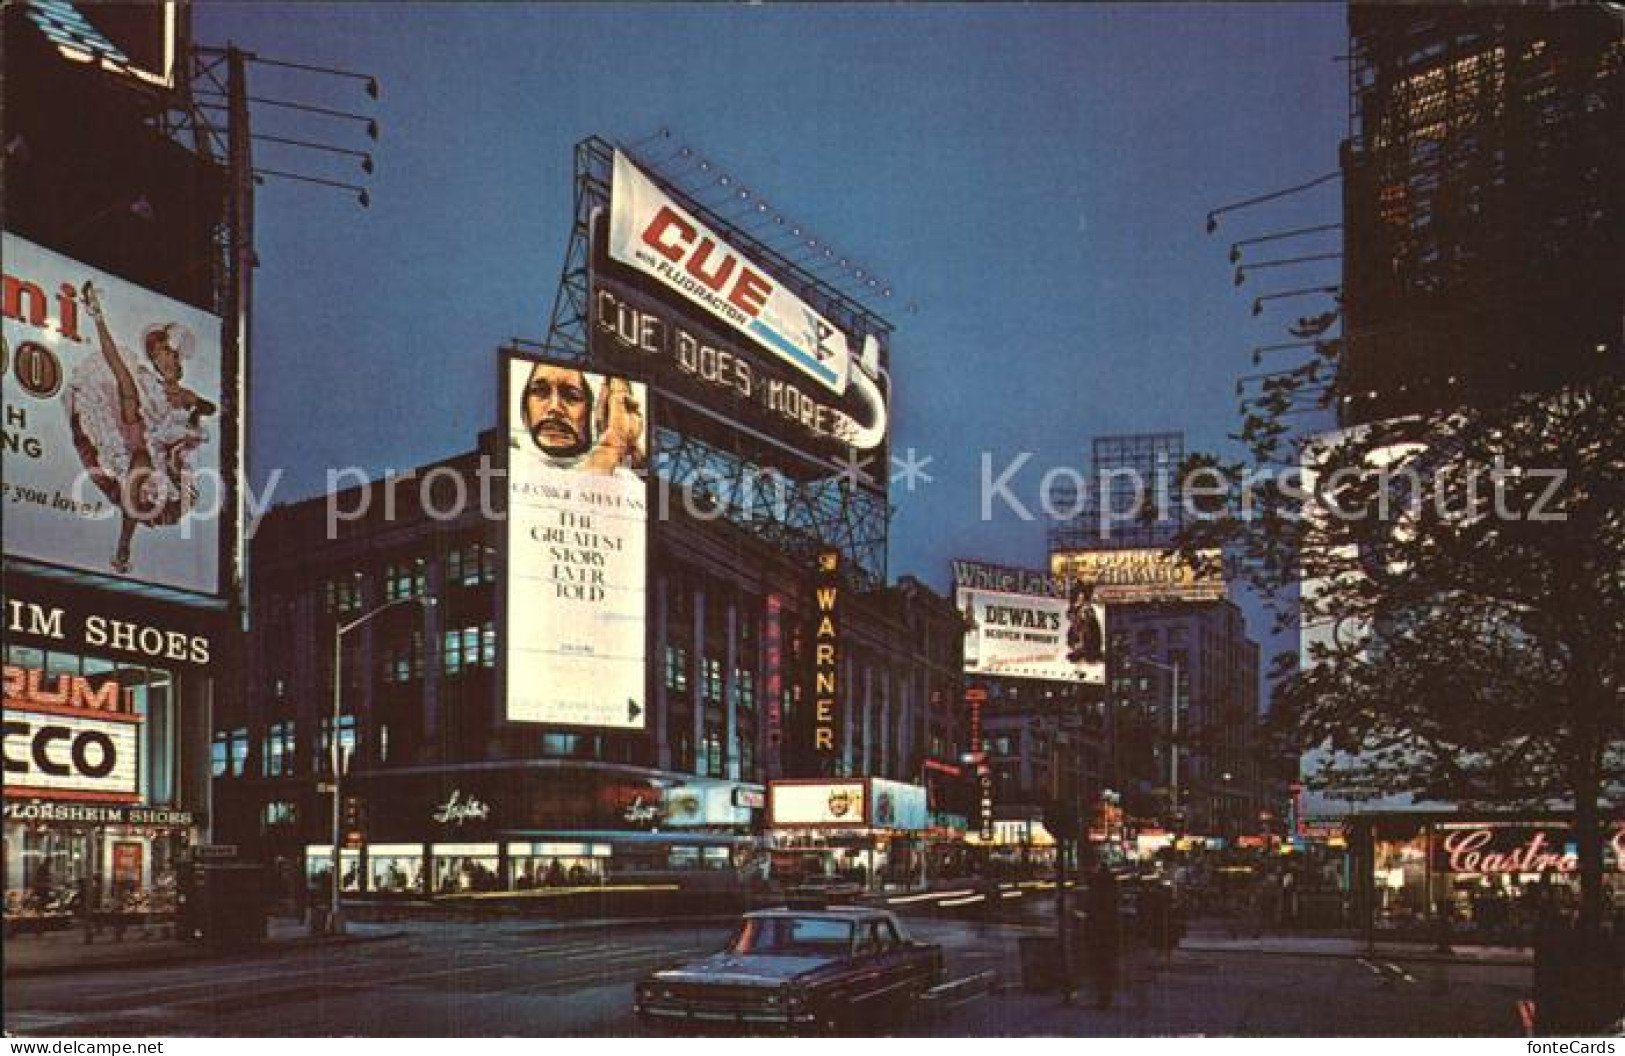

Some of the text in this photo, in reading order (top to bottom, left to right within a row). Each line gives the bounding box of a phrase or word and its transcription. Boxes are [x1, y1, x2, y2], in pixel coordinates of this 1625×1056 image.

[641, 205, 773, 318] CUE
[599, 288, 828, 437] CUE DOES MORE
[559, 511, 591, 529] THE
[530, 526, 623, 551] GREATEST
[549, 547, 606, 567] STORY
[552, 564, 604, 584] EVER
[555, 583, 605, 602] TOLD
[985, 605, 1060, 630] DEWAR'S
[85, 615, 211, 664] SHOES
[815, 586, 837, 750] WARNER
[130, 811, 193, 825] SHOES
[1444, 830, 1578, 873] Castro
